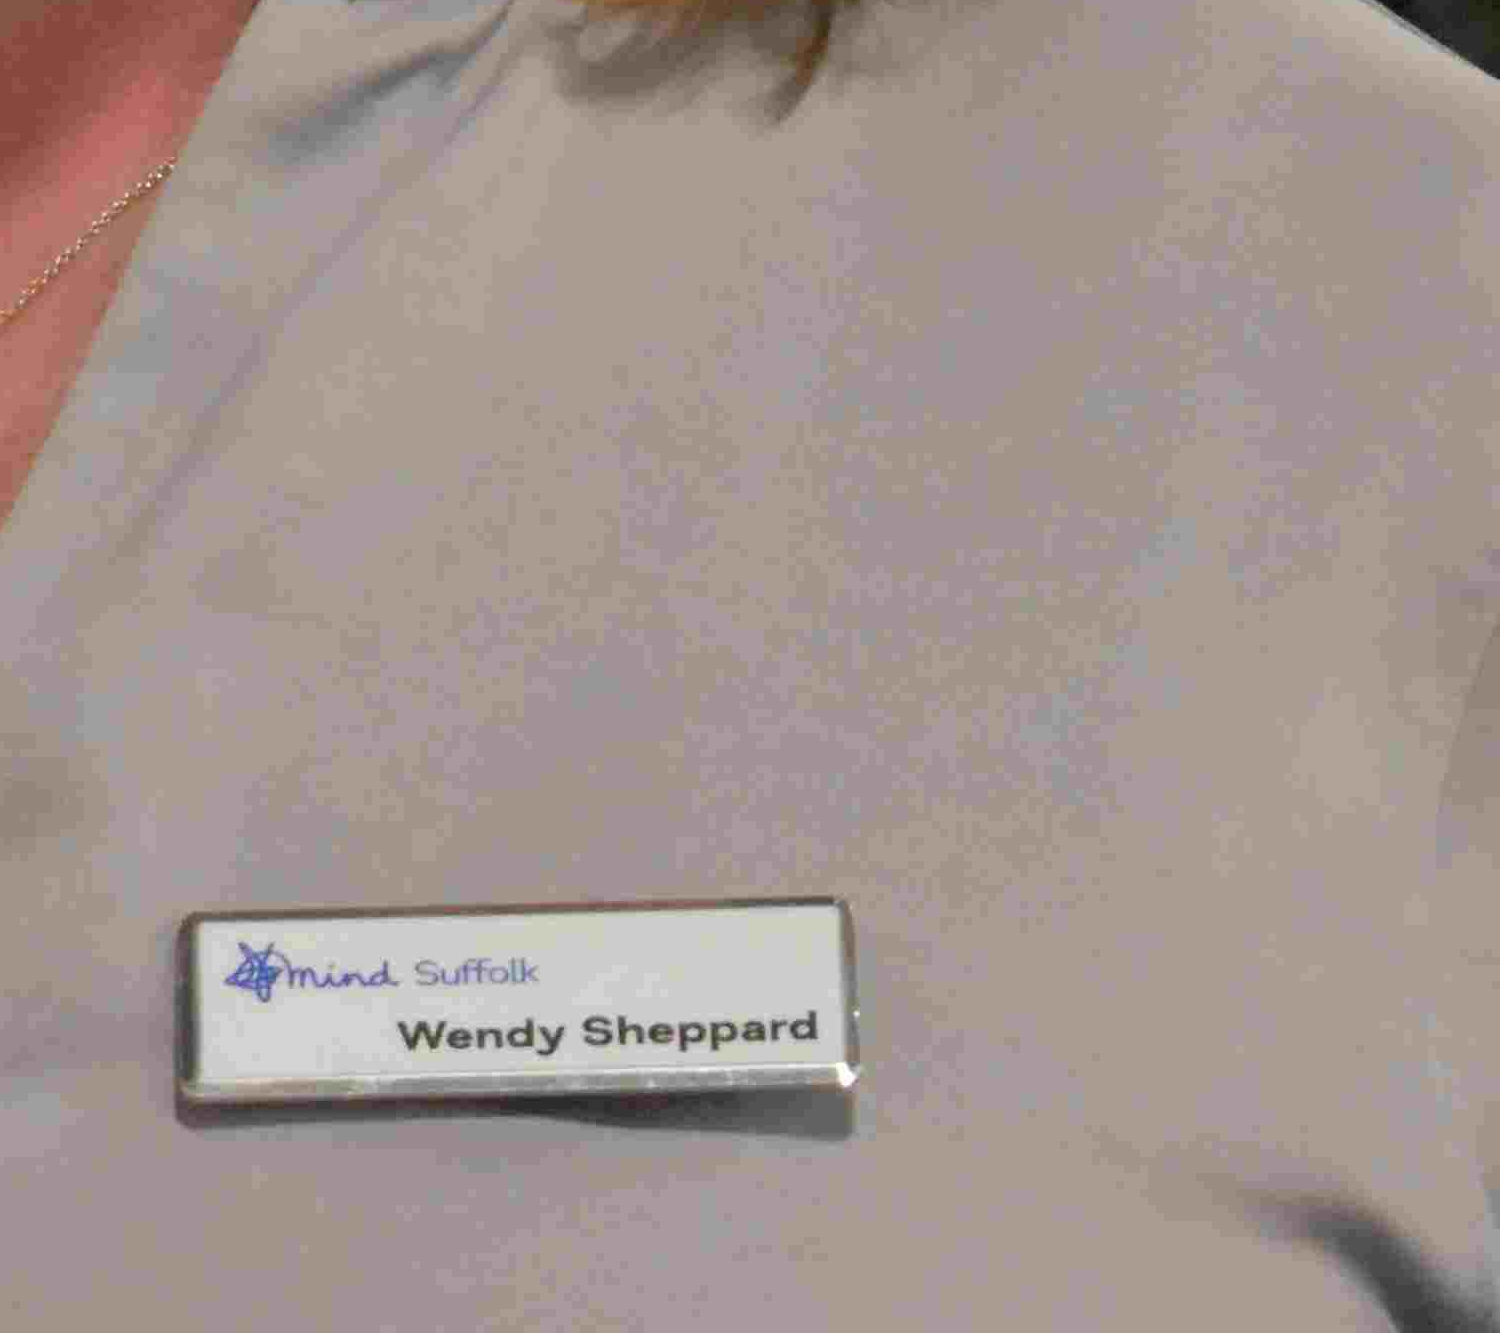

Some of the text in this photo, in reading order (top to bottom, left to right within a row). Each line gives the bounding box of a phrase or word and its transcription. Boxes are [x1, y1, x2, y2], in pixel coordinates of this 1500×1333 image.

[287, 959, 539, 989] mind Suffolk
[397, 1011, 819, 1055] Wendy Sheppard
